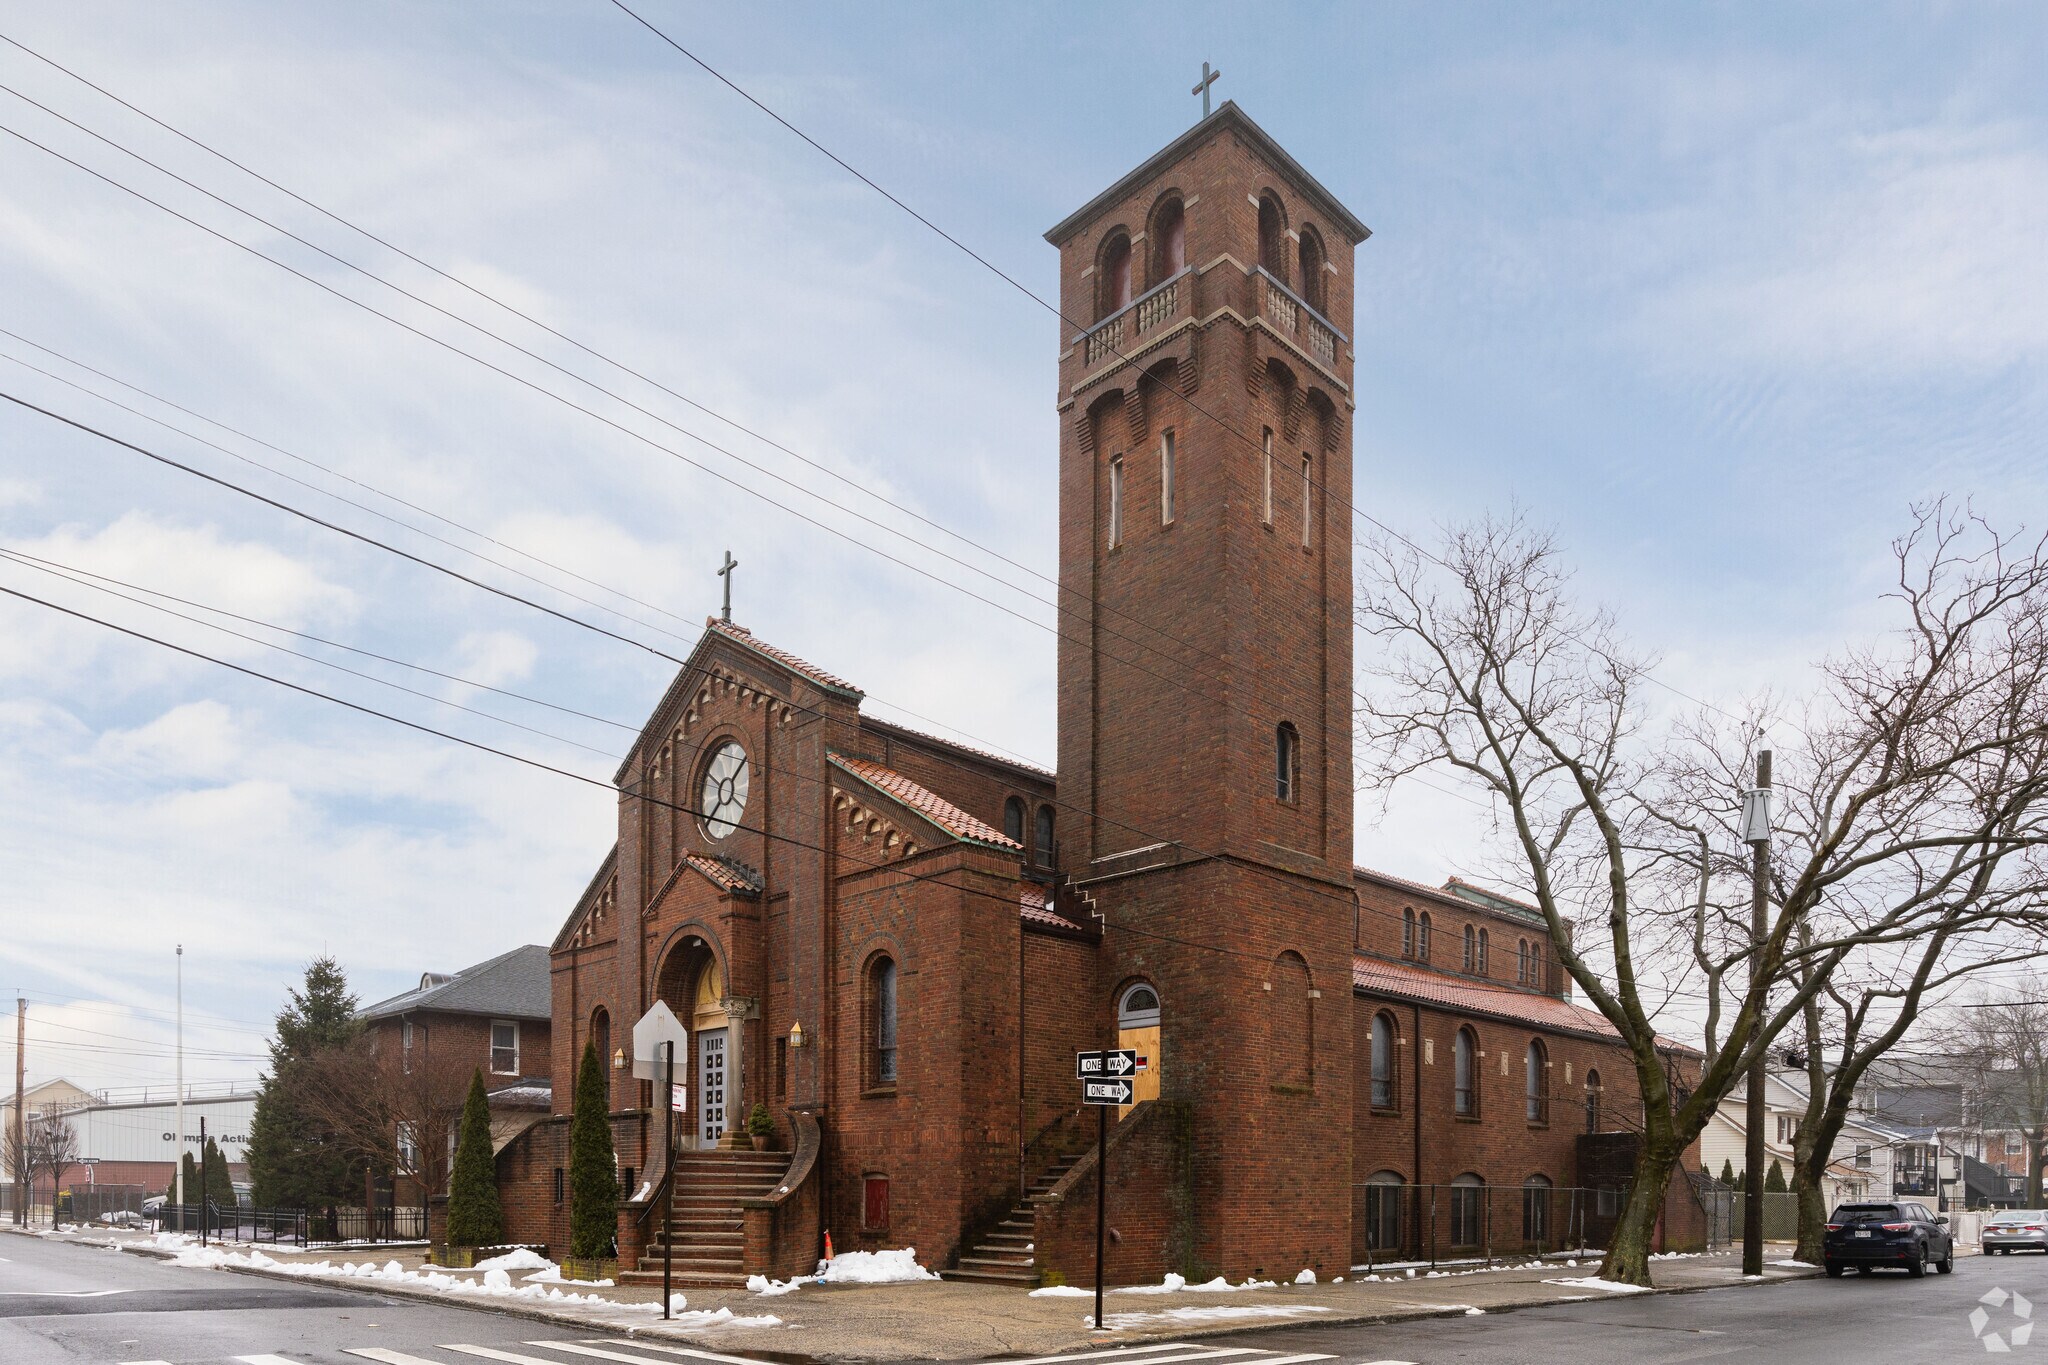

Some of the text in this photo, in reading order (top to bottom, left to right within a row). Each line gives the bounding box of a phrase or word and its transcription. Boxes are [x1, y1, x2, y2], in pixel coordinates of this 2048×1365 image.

[1086, 1059, 1127, 1070] ONE WAY
[1091, 1085, 1125, 1096] ONE WAY
[162, 1132, 215, 1144] Olmpia
